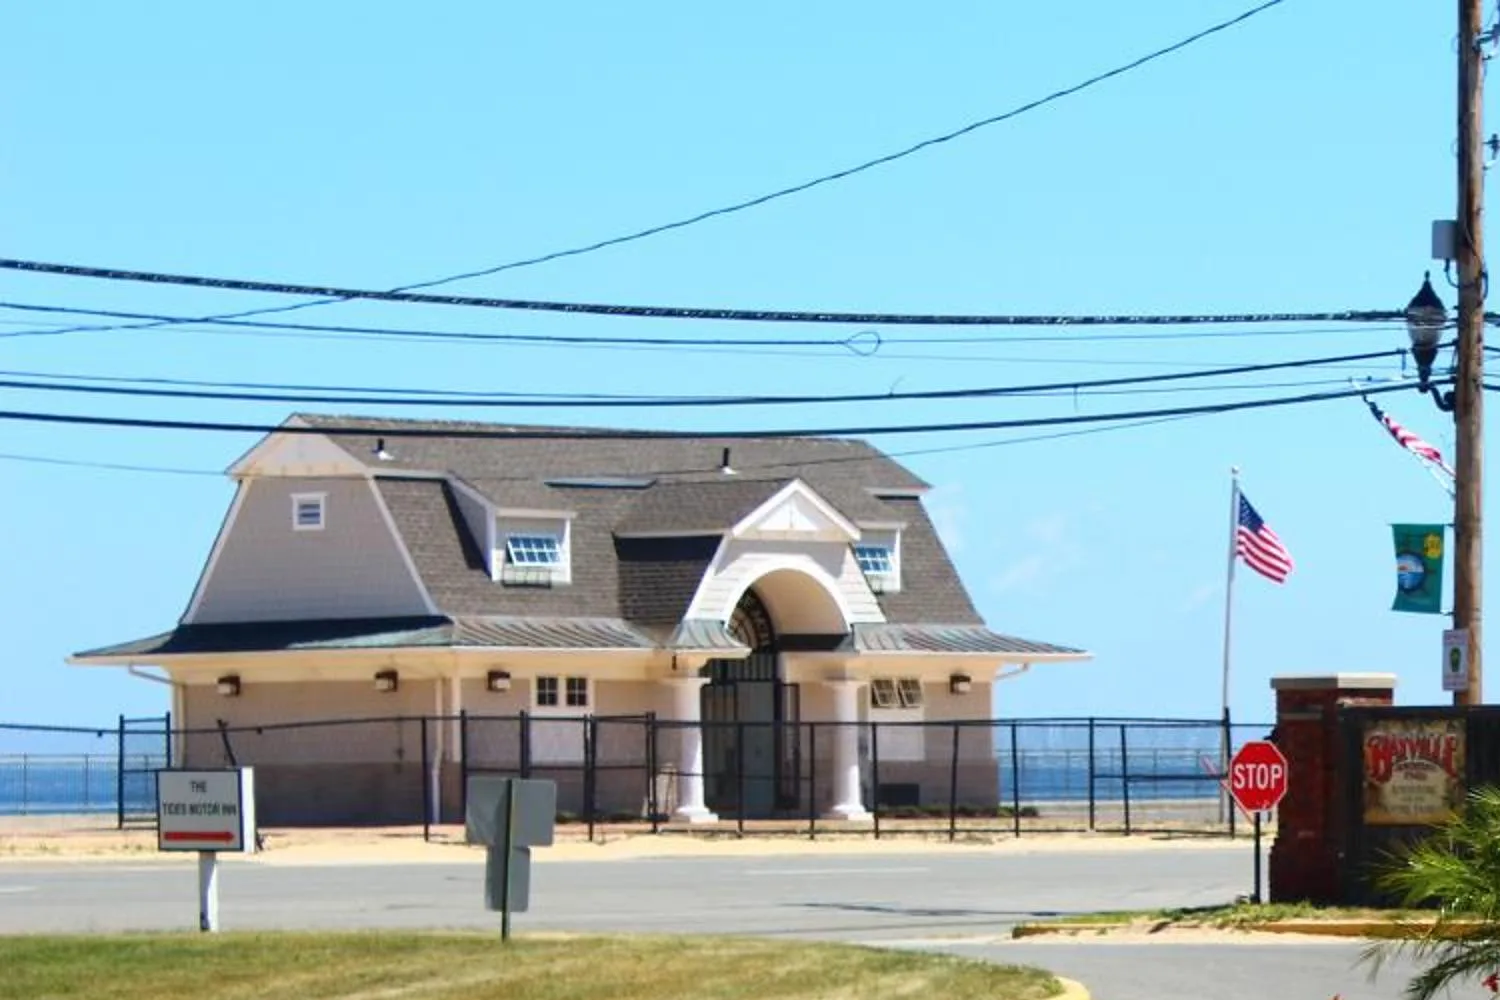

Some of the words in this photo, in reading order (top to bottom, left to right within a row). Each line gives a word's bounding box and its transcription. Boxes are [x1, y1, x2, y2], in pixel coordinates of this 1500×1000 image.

[1233, 763, 1283, 789] STOP
[189, 780, 207, 793] THE
[189, 802, 220, 816] MOTOR
[221, 802, 237, 816] INN
